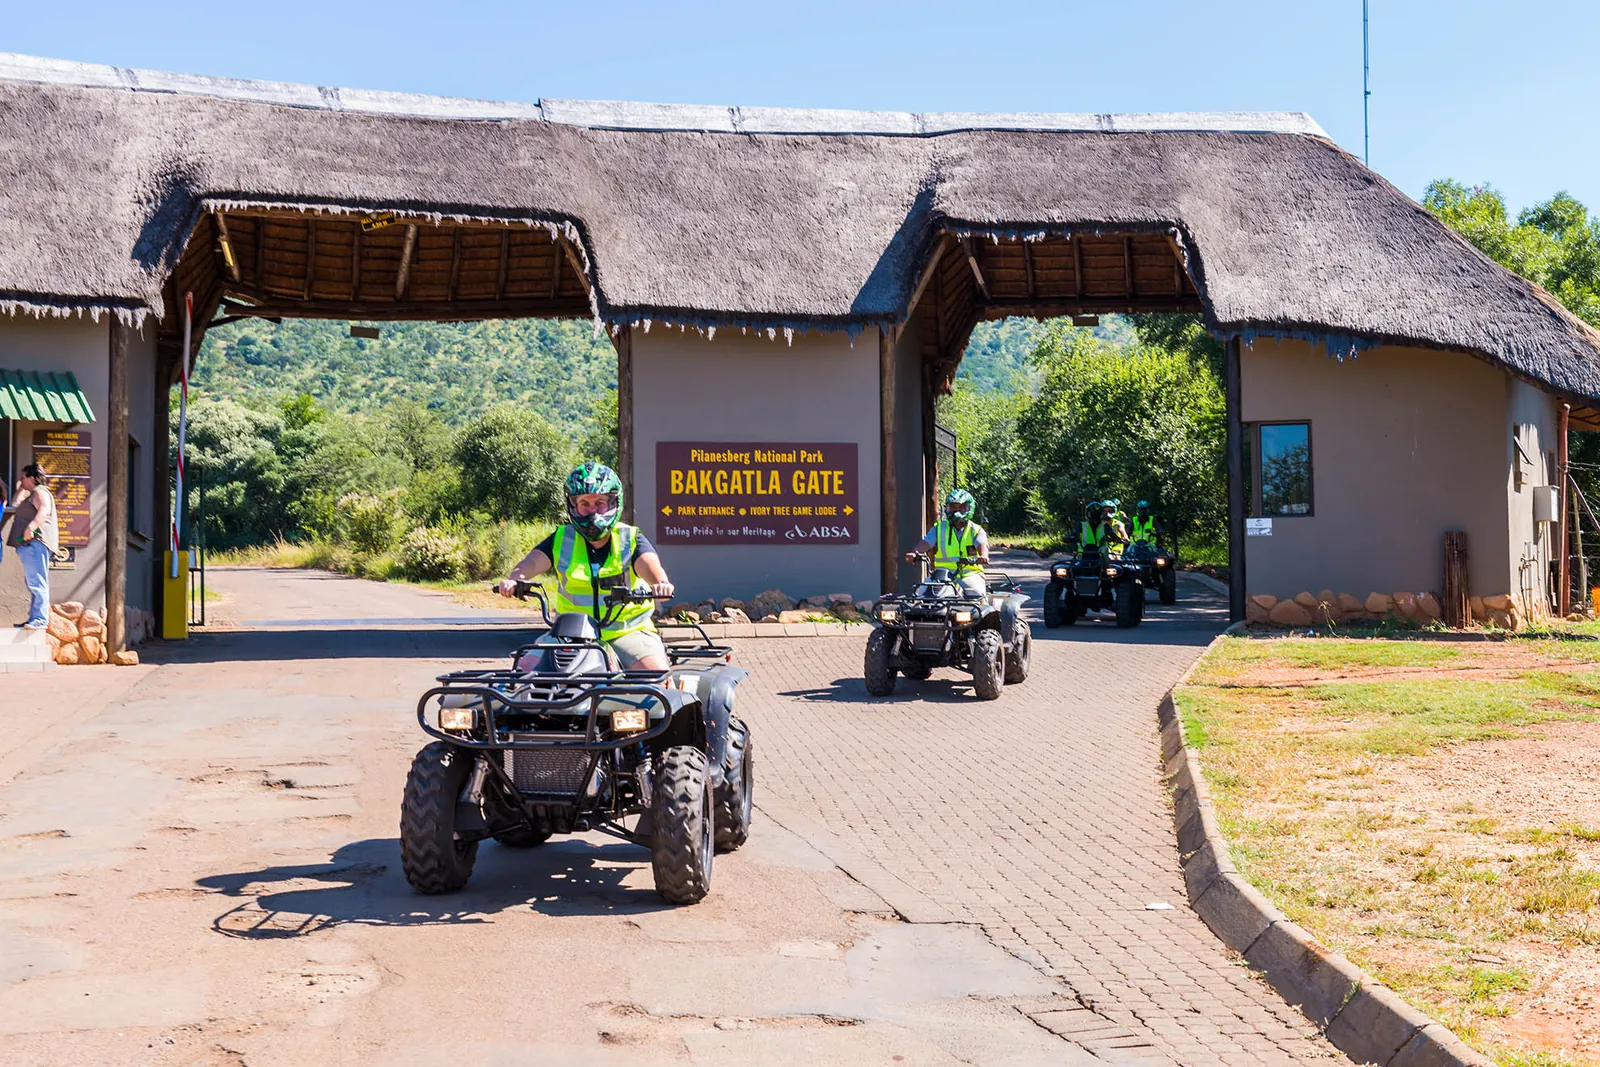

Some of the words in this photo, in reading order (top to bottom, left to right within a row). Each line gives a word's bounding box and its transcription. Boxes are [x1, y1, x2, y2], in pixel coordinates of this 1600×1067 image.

[691, 449, 750, 465] Pilanesberg
[754, 449, 796, 463] National
[801, 450, 824, 463] Park
[670, 469, 782, 495] BAKGATLA
[792, 470, 845, 495] GATE
[677, 506, 696, 516] PARK
[699, 506, 735, 516] ENTRANCE
[750, 506, 771, 516] IVORY
[773, 506, 790, 516] TREE
[792, 506, 812, 516] GAME
[815, 506, 837, 516] LODGE
[665, 526, 691, 538] Taking
[693, 526, 713, 536] Pride
[716, 527, 724, 535] in
[727, 528, 740, 536] our
[742, 526, 776, 538] Heritage
[809, 526, 851, 538] ABSA
